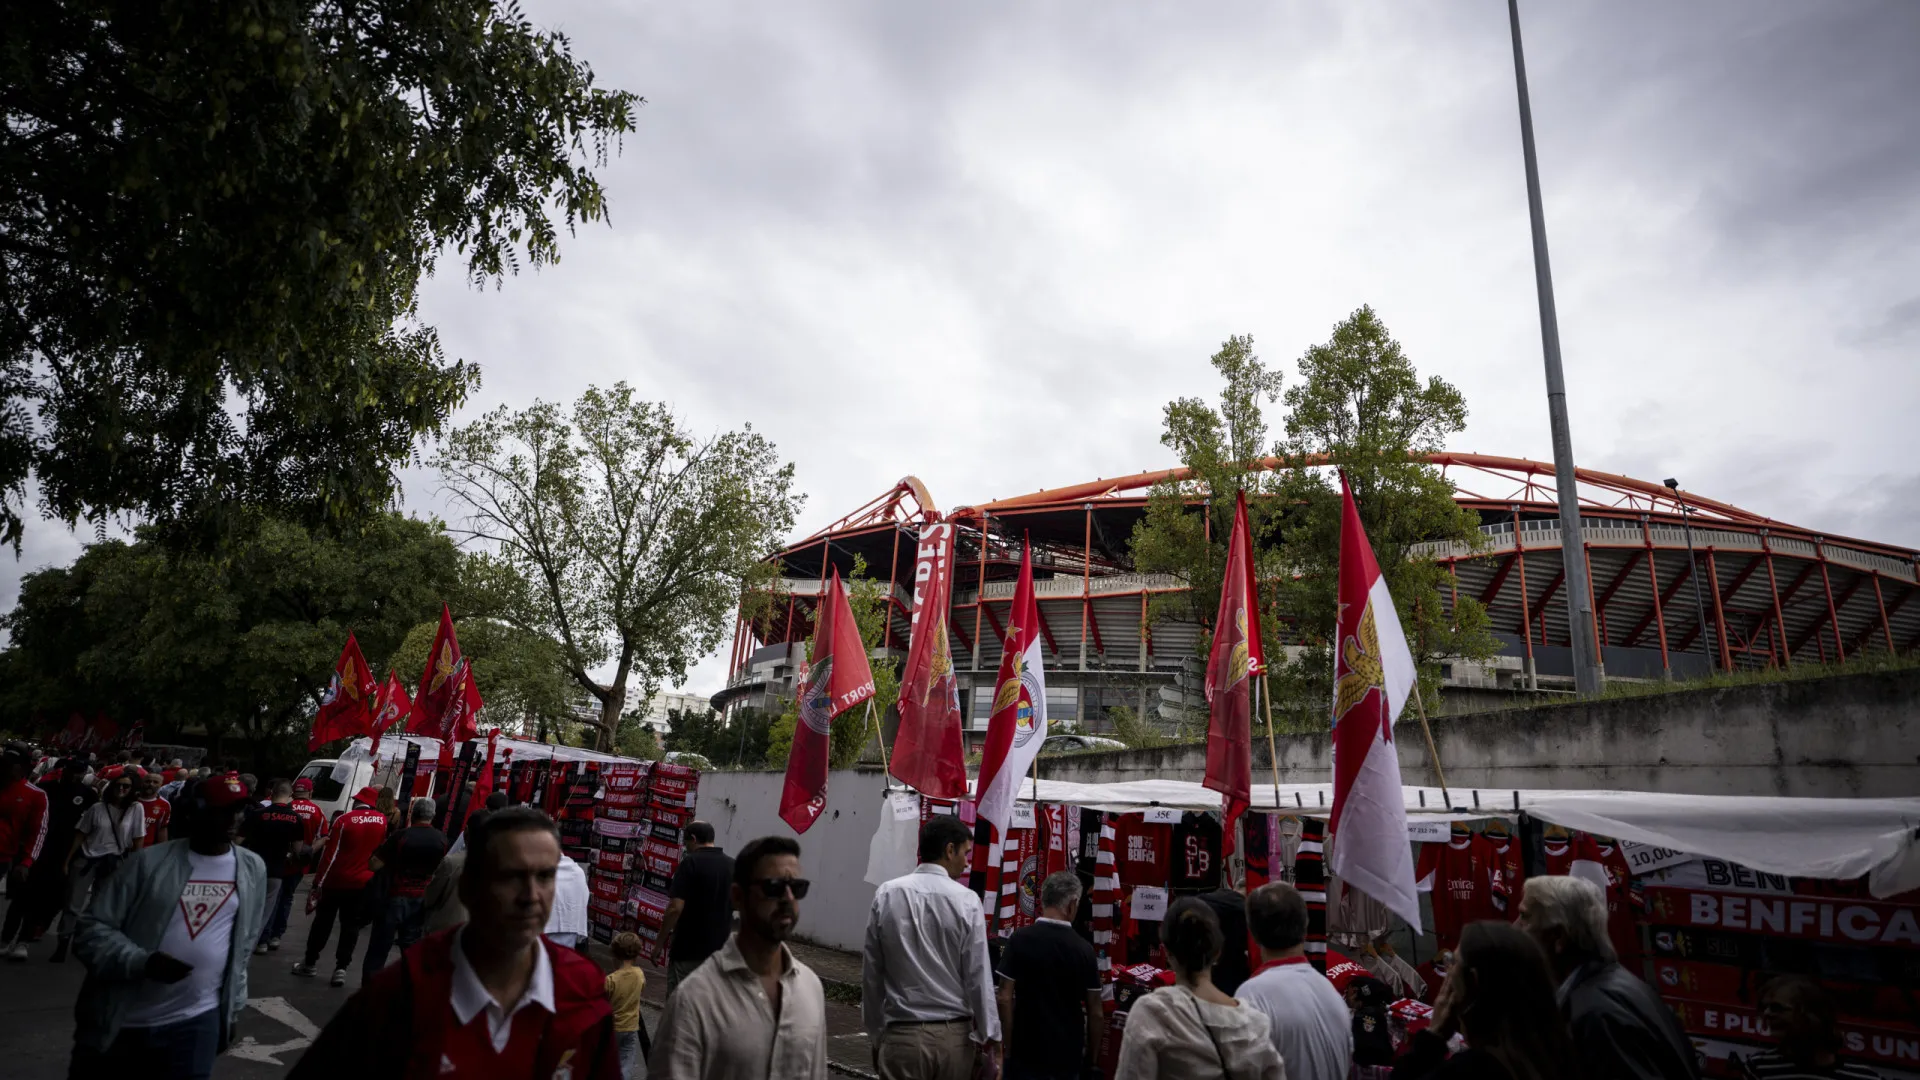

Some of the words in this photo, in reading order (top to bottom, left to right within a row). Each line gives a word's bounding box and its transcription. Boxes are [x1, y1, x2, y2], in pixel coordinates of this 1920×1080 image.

[292, 803, 316, 813] SAGRES
[271, 812, 298, 823] SAGRES
[358, 815, 384, 825] SAGRES
[1127, 835, 1144, 849] SOU
[1689, 893, 1920, 945] BENFICA
[1703, 1009, 1720, 1029] E
